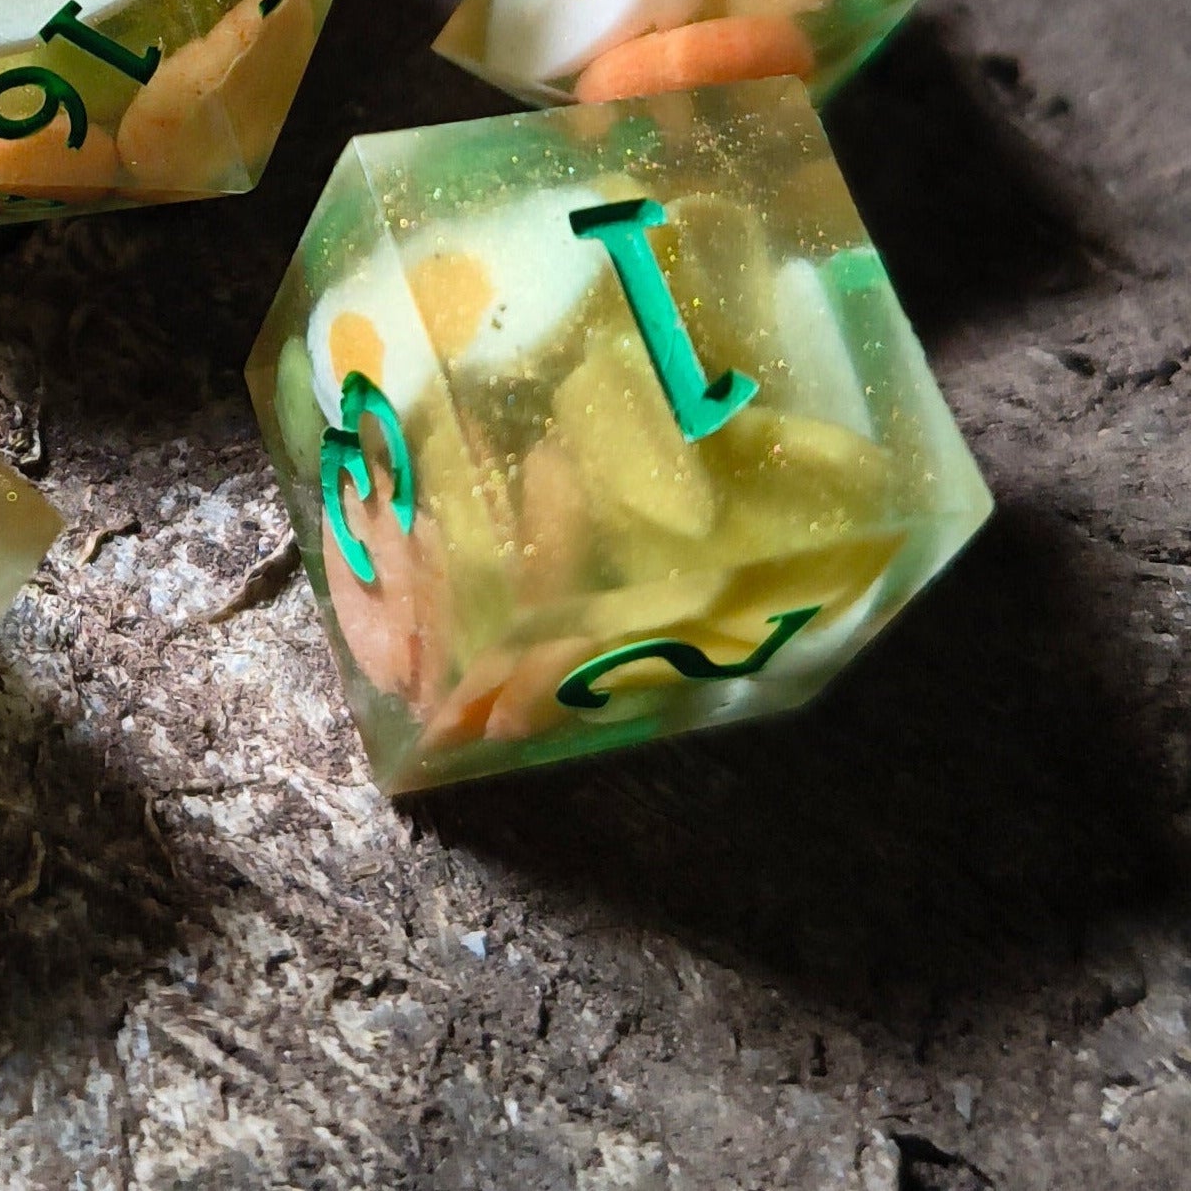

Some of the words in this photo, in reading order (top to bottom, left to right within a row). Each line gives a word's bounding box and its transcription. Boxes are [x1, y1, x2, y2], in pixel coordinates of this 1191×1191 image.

[569, 196, 760, 444] 1
[320, 369, 415, 585] 3
[555, 605, 823, 709] 2
